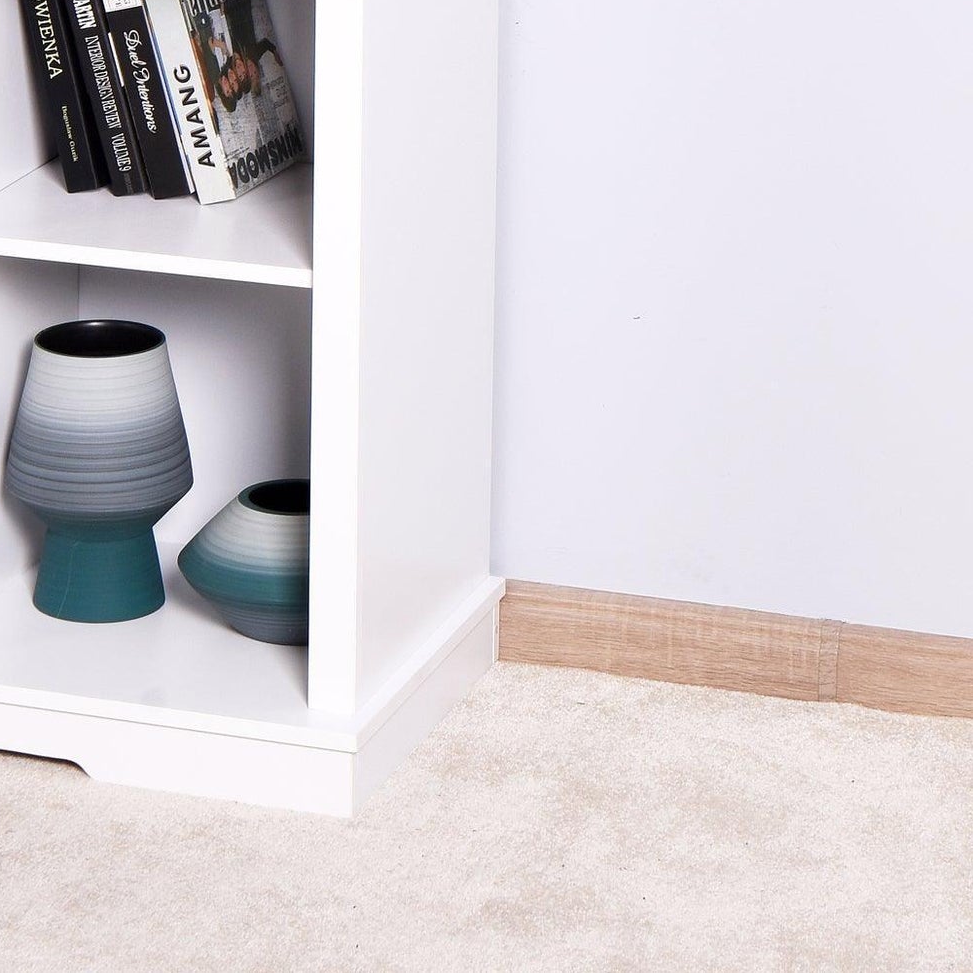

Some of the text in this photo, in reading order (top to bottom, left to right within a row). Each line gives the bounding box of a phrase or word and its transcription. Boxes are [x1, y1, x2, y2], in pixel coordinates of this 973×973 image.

[85, 35, 122, 129] INTERIOR DESIGN REVIEW
[173, 64, 216, 168] AMANG
[111, 132, 132, 167] VOLUME
